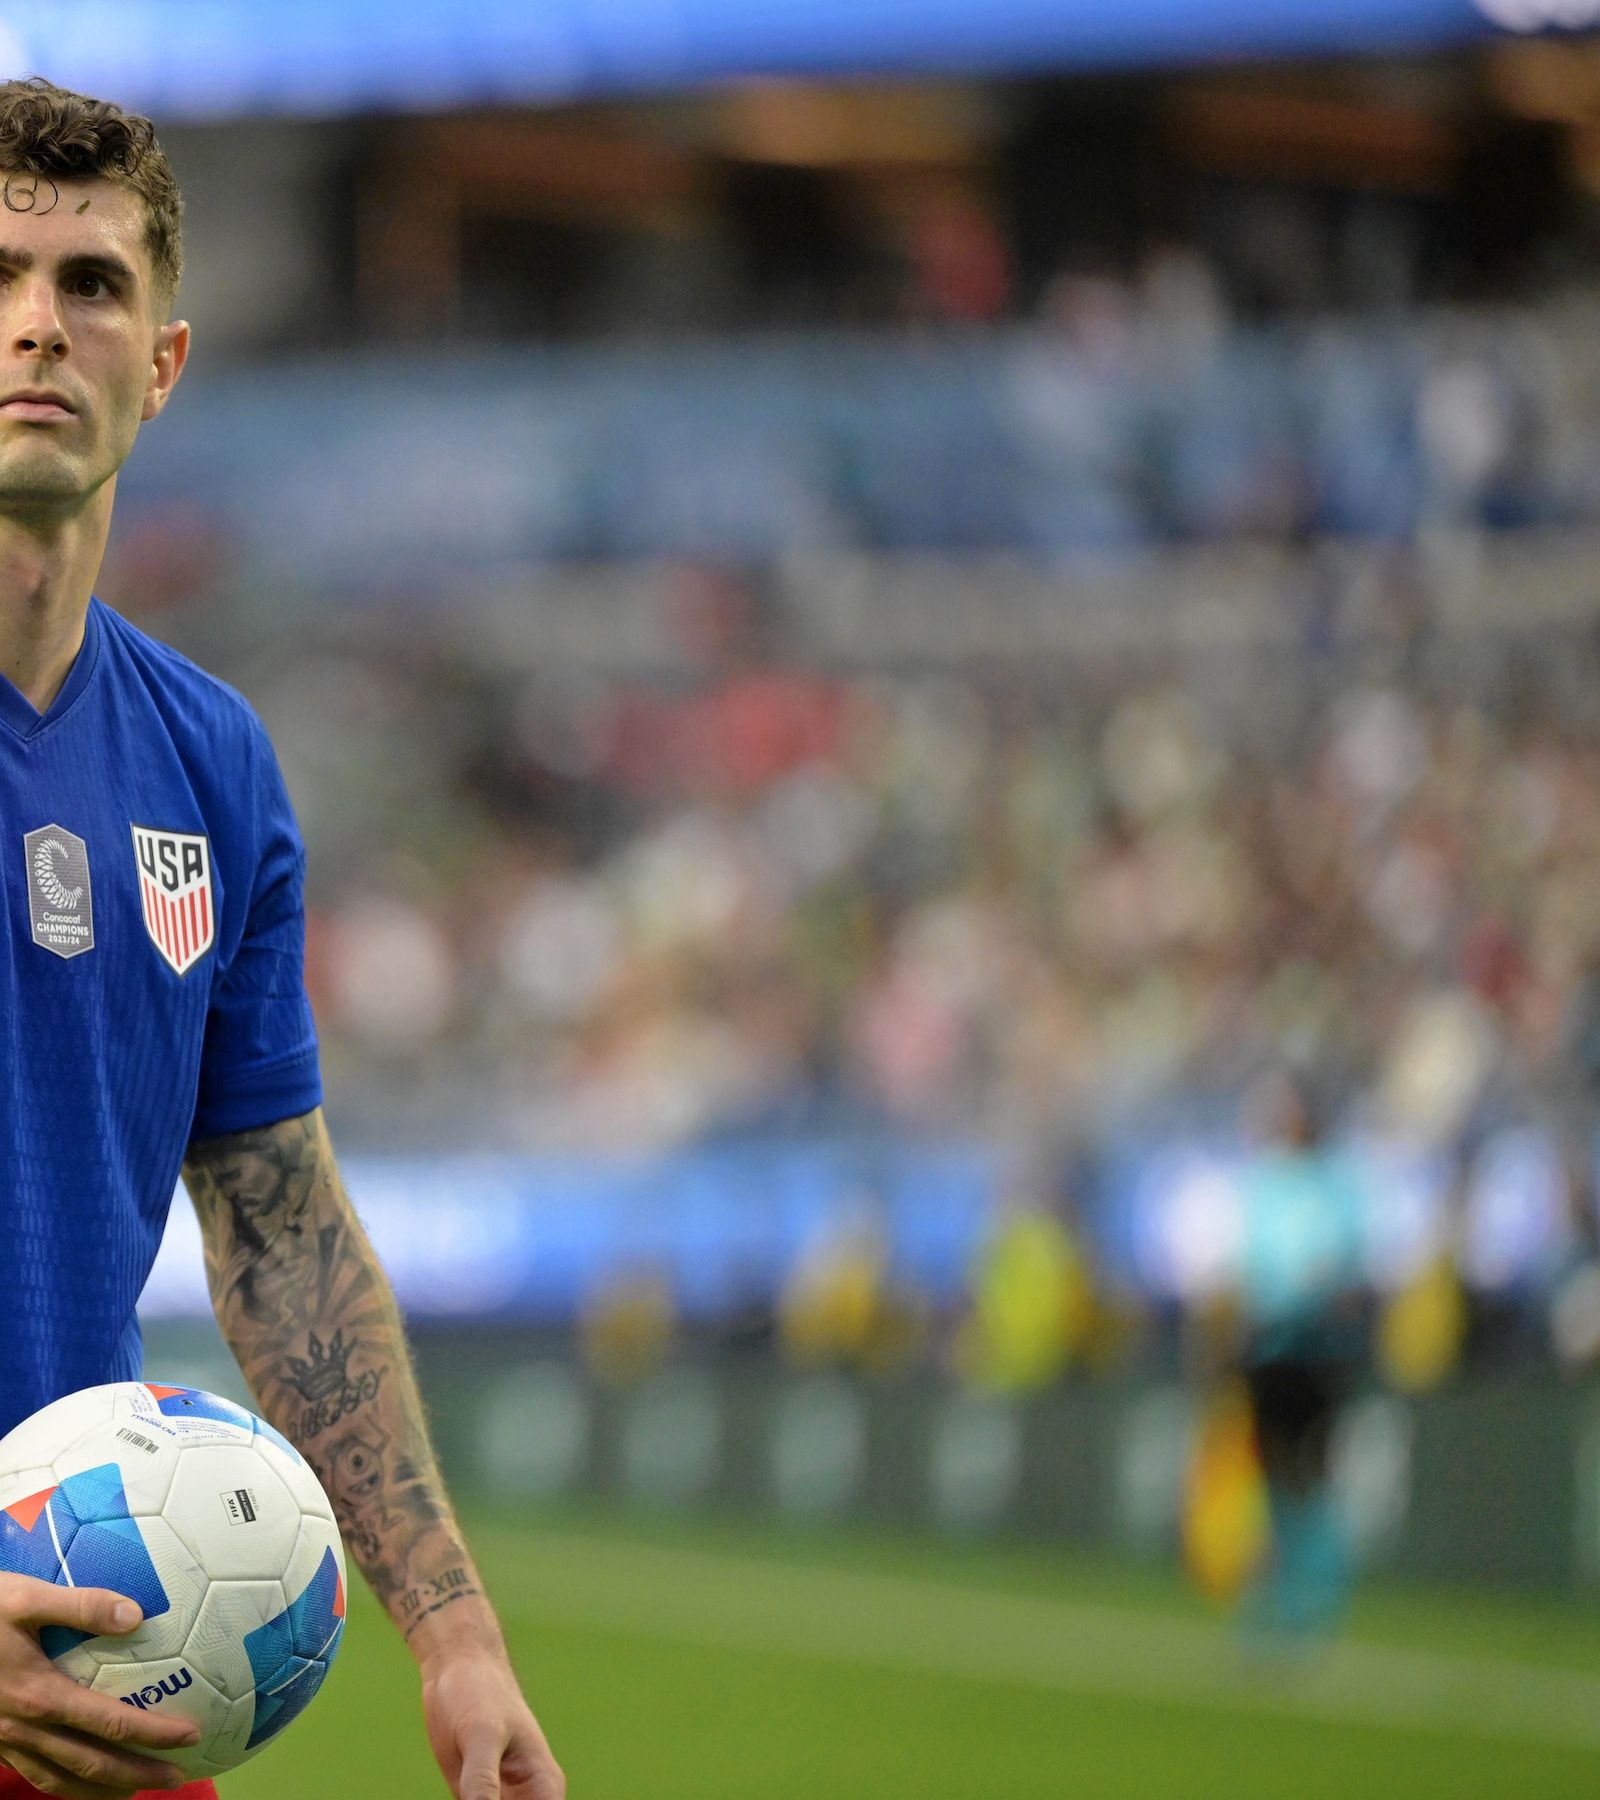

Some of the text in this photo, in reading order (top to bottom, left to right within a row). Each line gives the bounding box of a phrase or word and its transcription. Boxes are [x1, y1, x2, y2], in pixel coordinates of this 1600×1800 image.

[137, 834, 203, 892] USA
[43, 912, 81, 925] Concacaf
[37, 922, 89, 936] CHAMPIONS
[48, 934, 80, 945] 2023/24
[228, 1498, 240, 1518] FIFA
